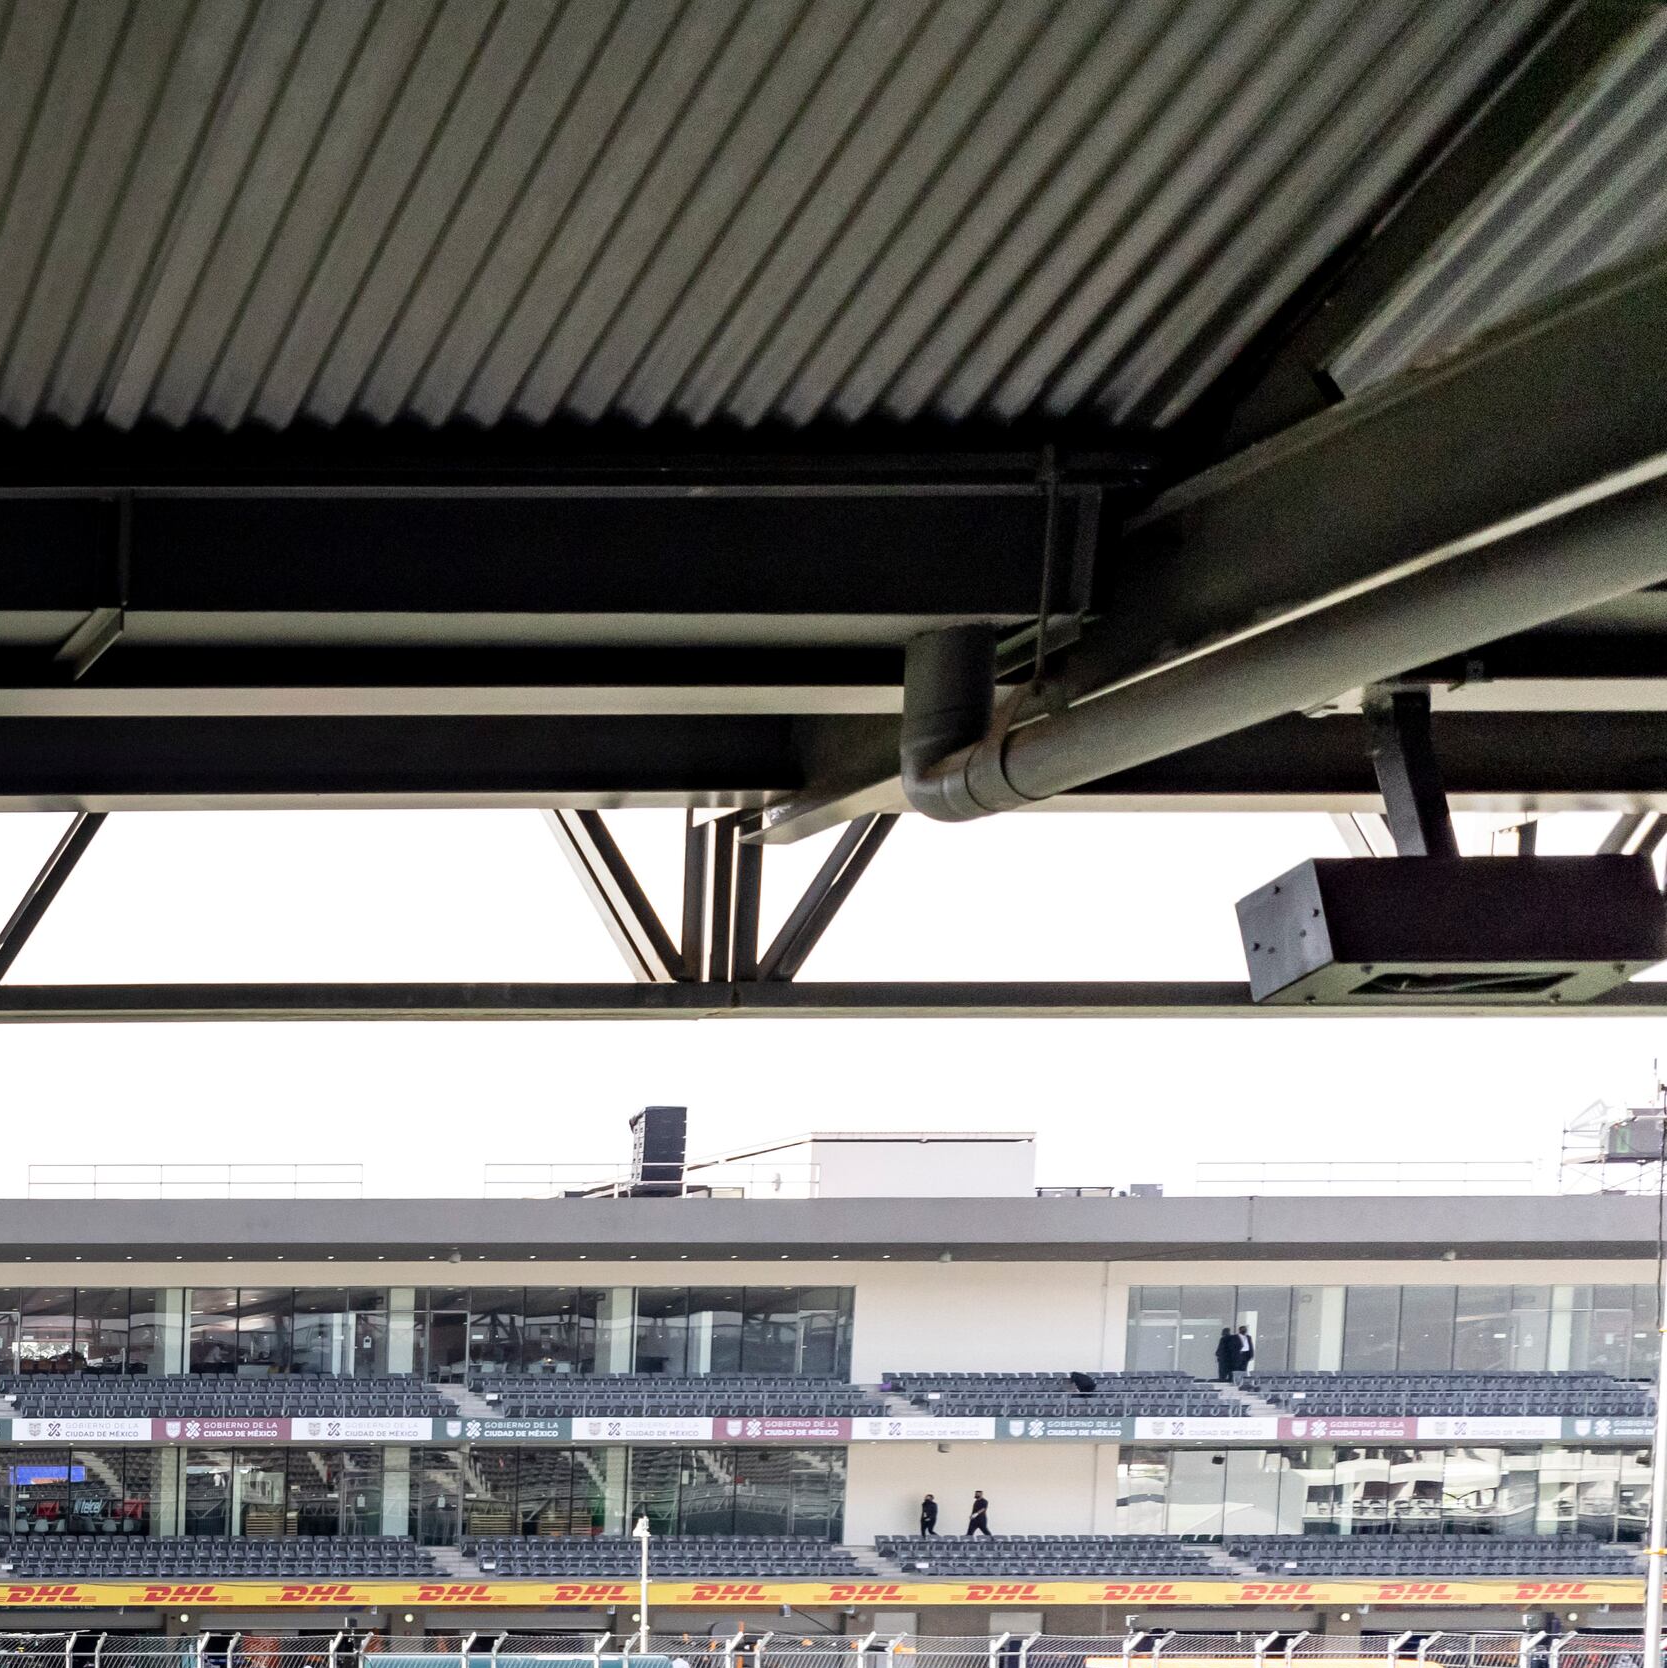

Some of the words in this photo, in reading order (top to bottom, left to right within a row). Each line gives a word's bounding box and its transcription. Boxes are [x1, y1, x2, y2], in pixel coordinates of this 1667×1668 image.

[247, 1429, 278, 1437] MÉXICO
[528, 1429, 559, 1437] MÉXICO
[7, 1586, 81, 1602] DHL
[143, 1586, 217, 1602] DHL
[280, 1586, 354, 1602] DHL
[417, 1586, 491, 1602] DHL
[554, 1586, 628, 1602] DHL
[692, 1585, 766, 1600] DHL
[828, 1585, 902, 1600] DHL
[966, 1585, 1040, 1600] DHL
[1103, 1585, 1177, 1600] DHL
[1241, 1585, 1315, 1600] DHL
[1378, 1585, 1452, 1600] DHL
[1516, 1584, 1590, 1600] DHL
